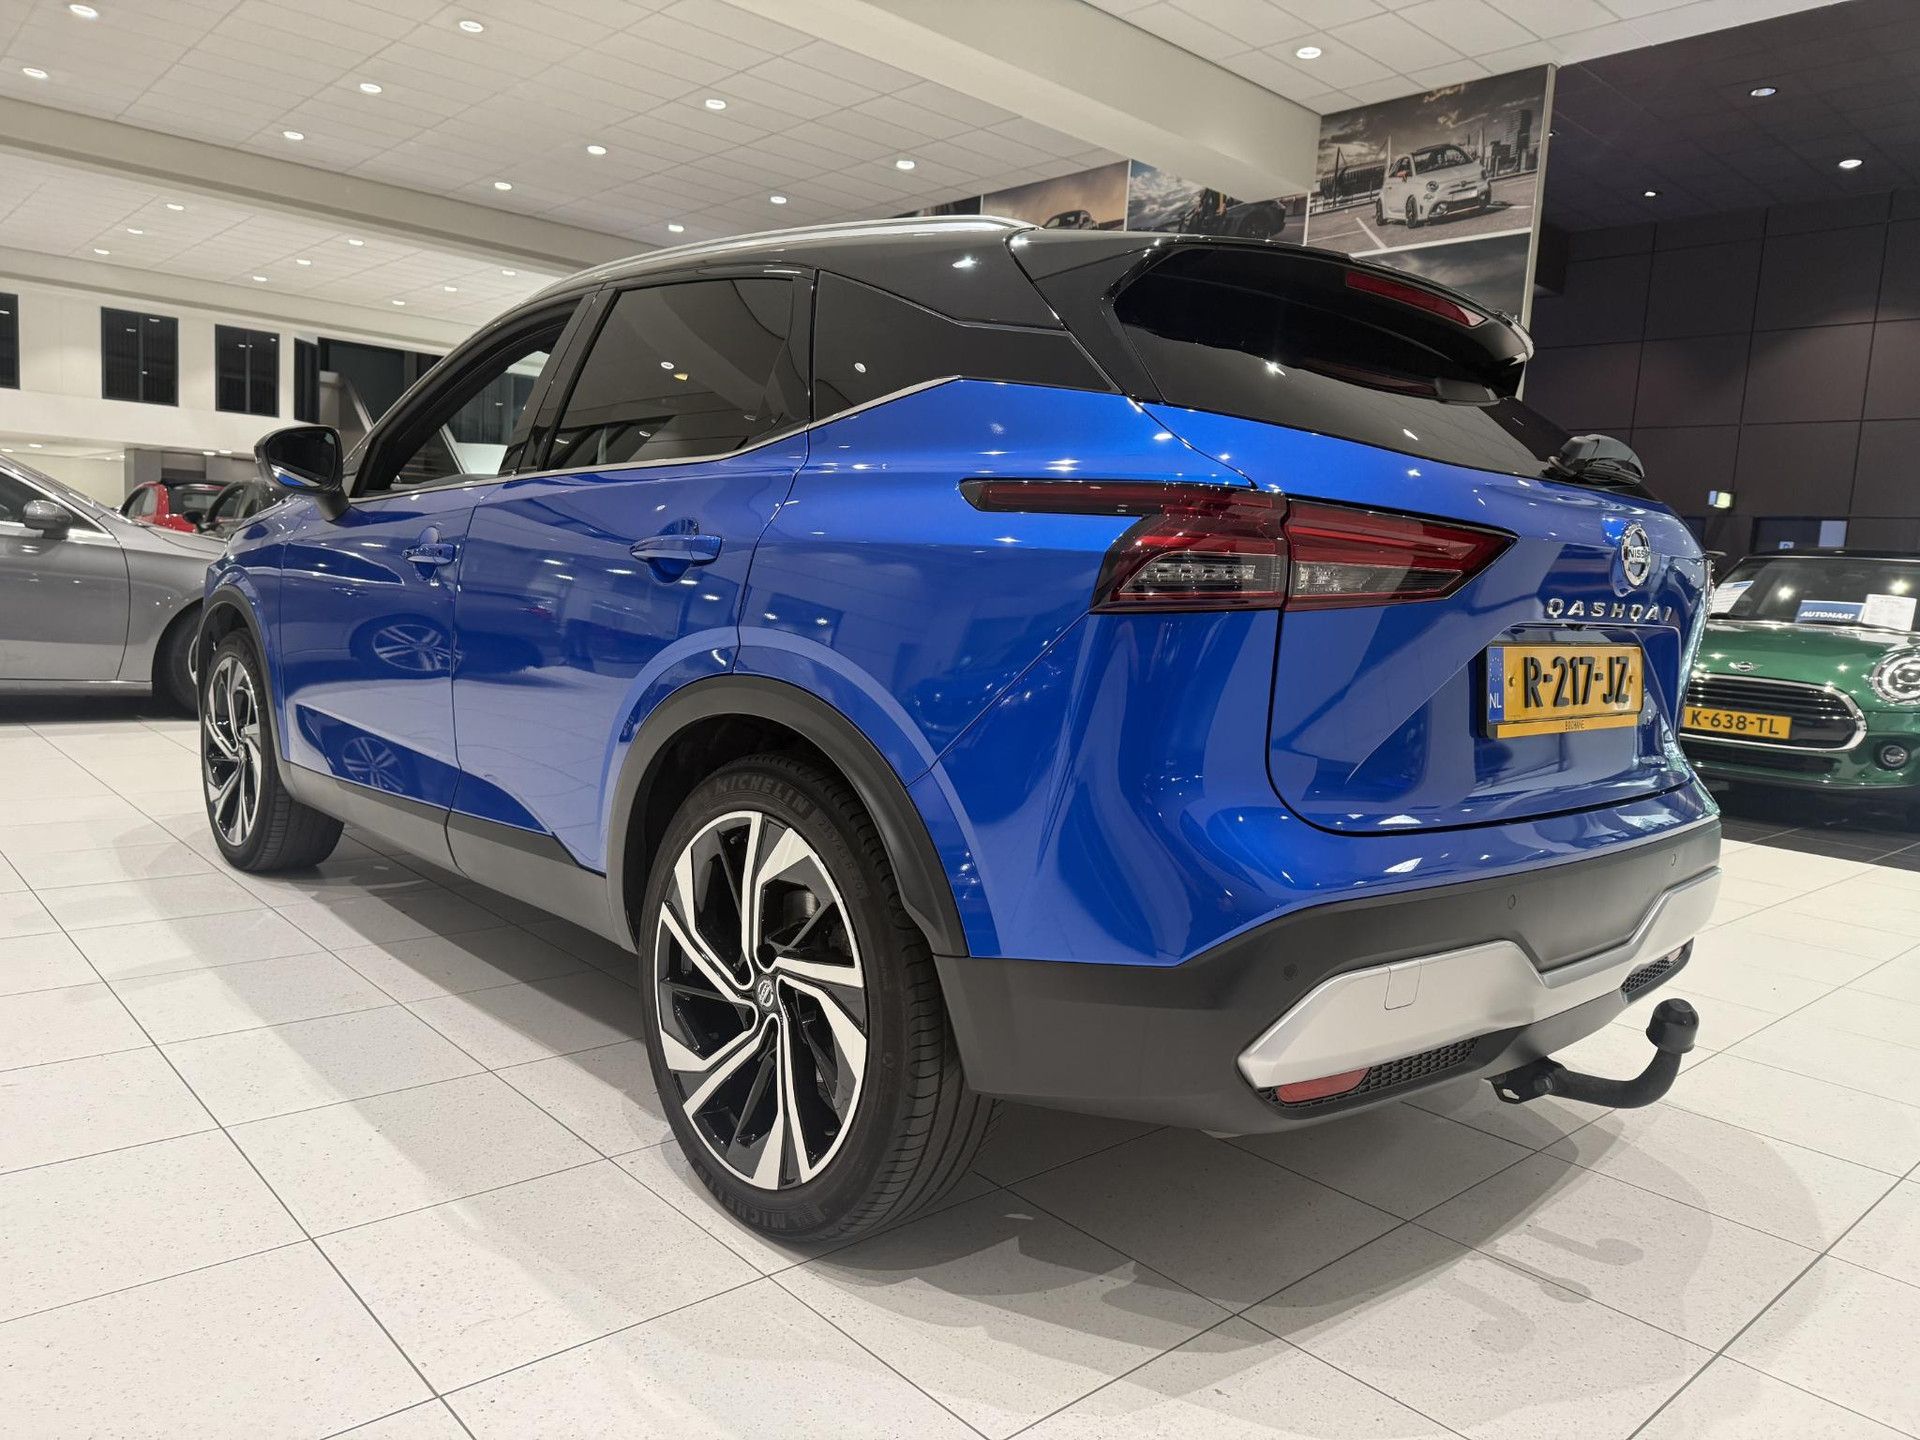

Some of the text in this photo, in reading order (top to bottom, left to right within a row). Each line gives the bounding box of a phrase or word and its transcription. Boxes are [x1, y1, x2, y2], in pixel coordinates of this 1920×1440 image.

[1547, 597, 1672, 623] QASHQAI
[1523, 656, 1630, 708] R-217-JZ
[1489, 693, 1502, 709] NL
[1691, 710, 1779, 735] K-638-TL
[715, 774, 811, 814] MICHELIN
